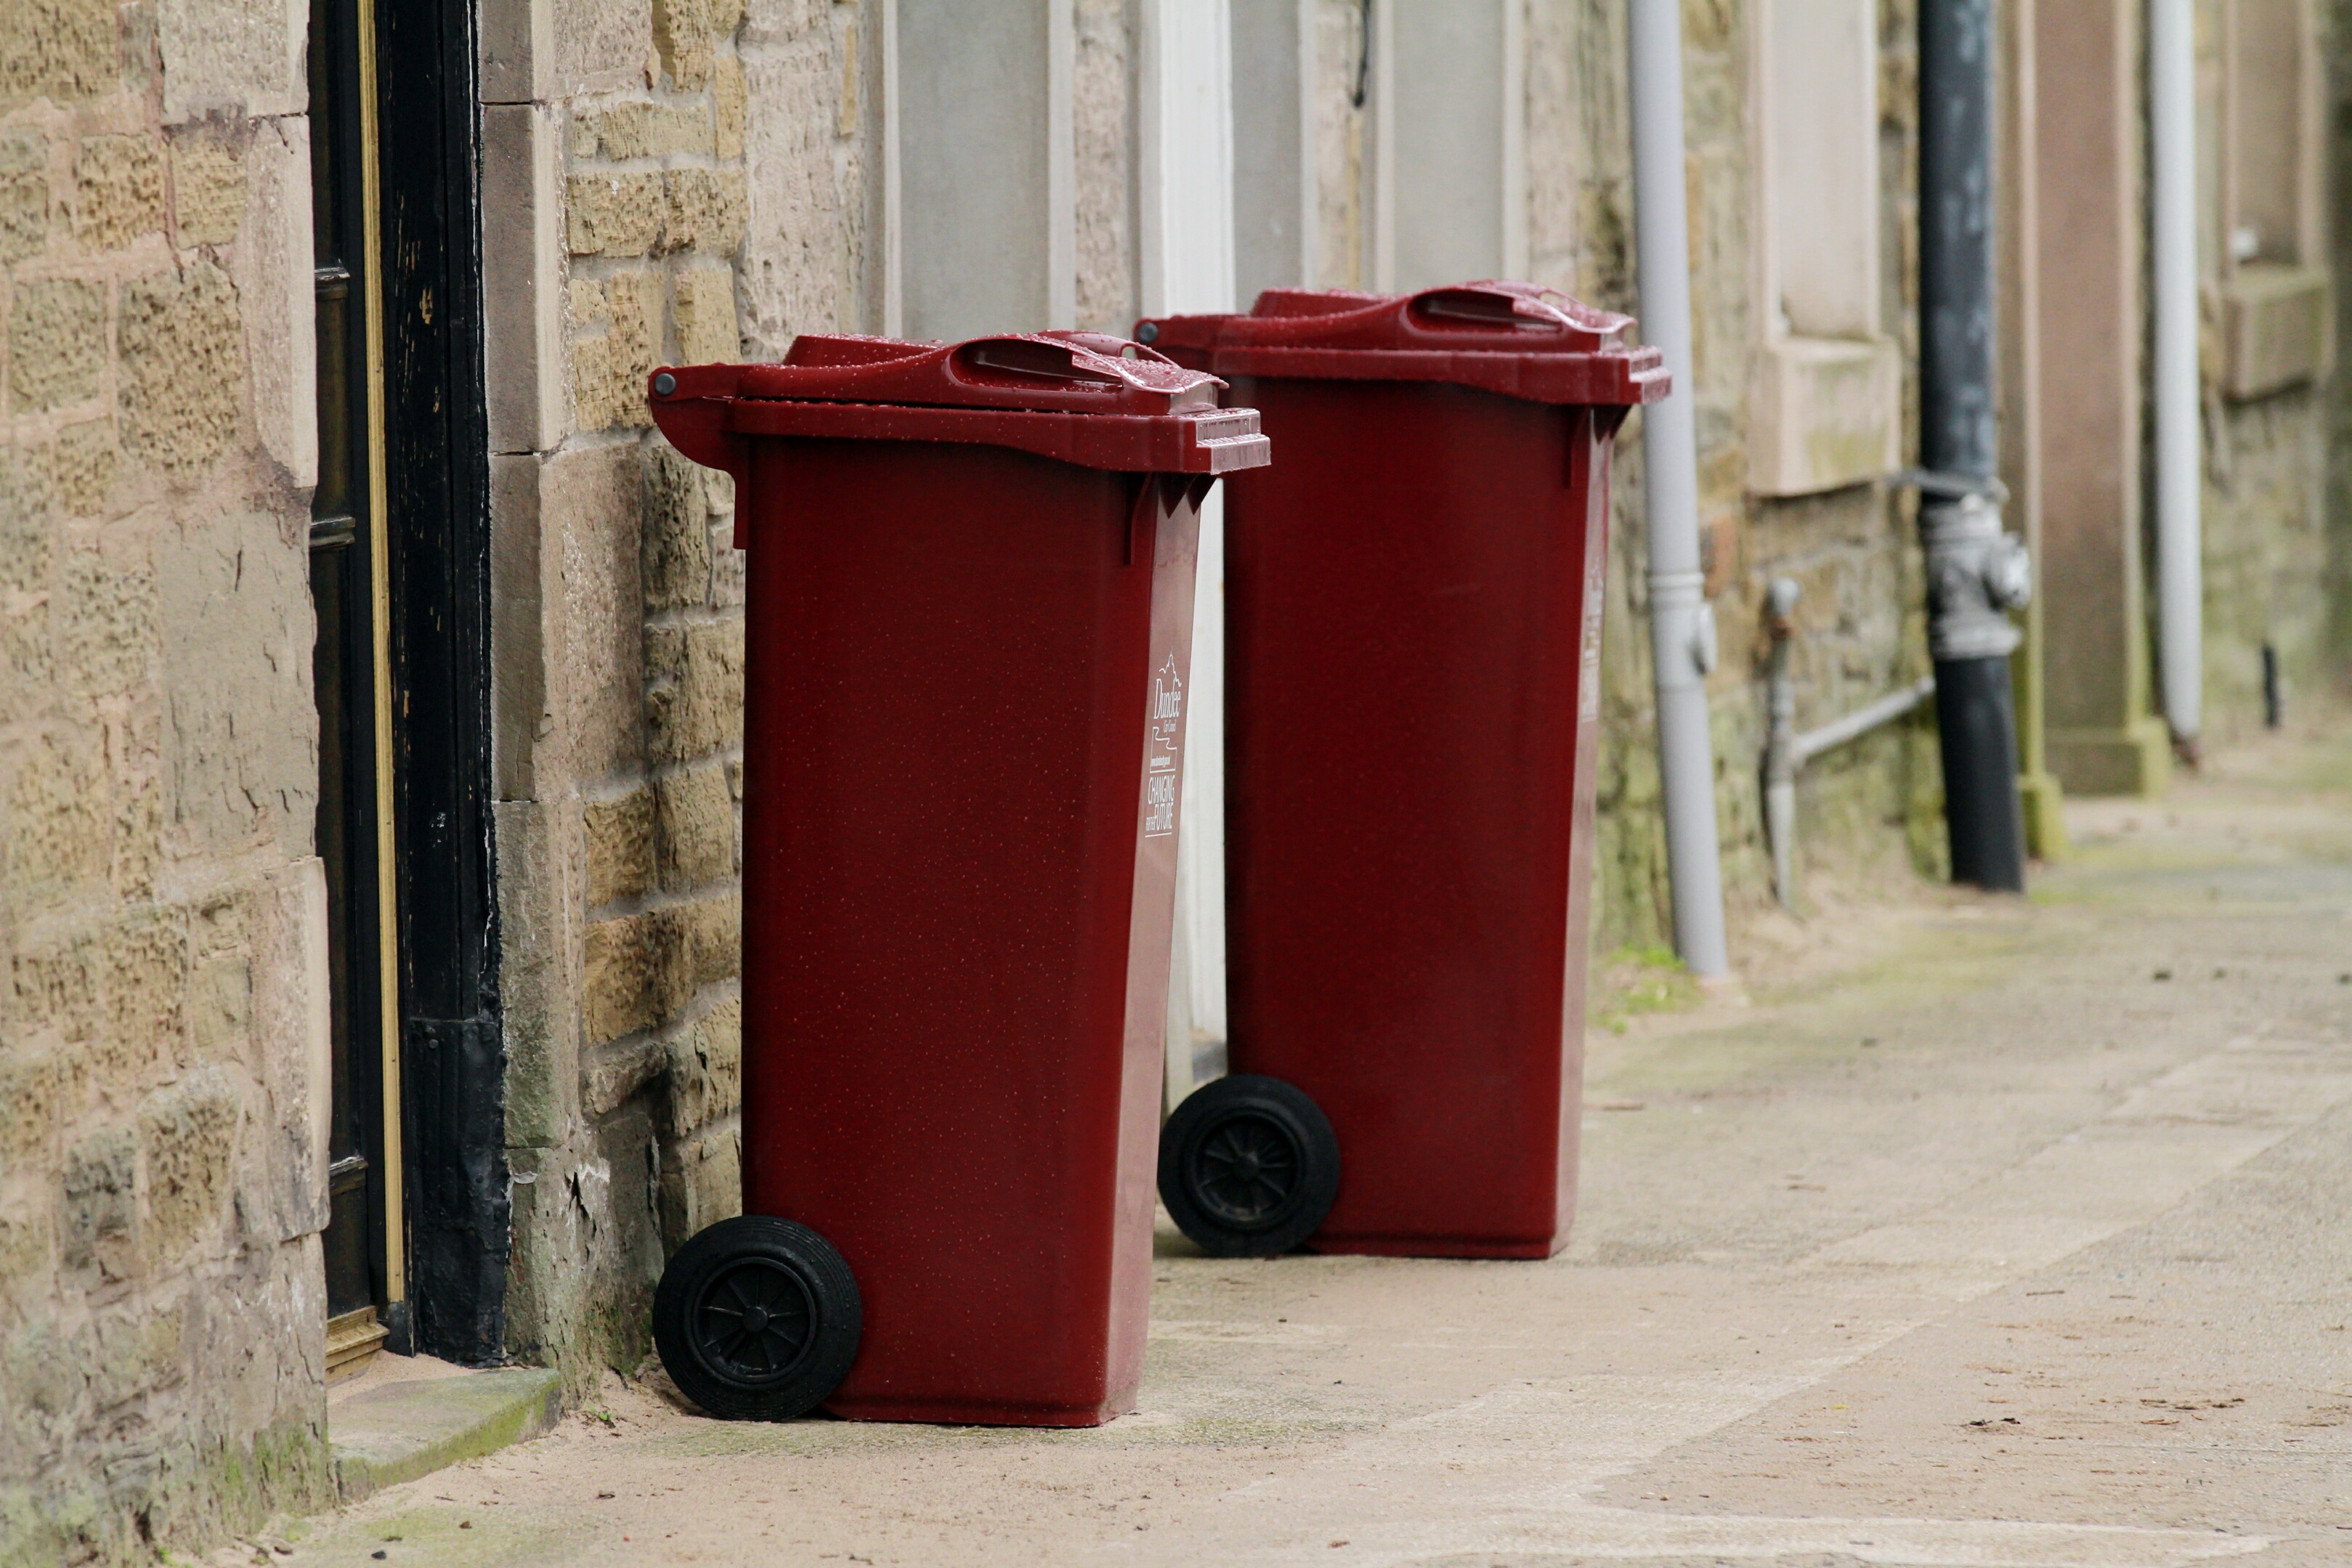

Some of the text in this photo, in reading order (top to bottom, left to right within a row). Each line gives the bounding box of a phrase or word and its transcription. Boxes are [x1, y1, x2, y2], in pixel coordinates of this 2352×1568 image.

[1153, 678, 1181, 719] Dundee
[1148, 775, 1175, 805] CHANGING
[1154, 802, 1174, 831] FUTURE
